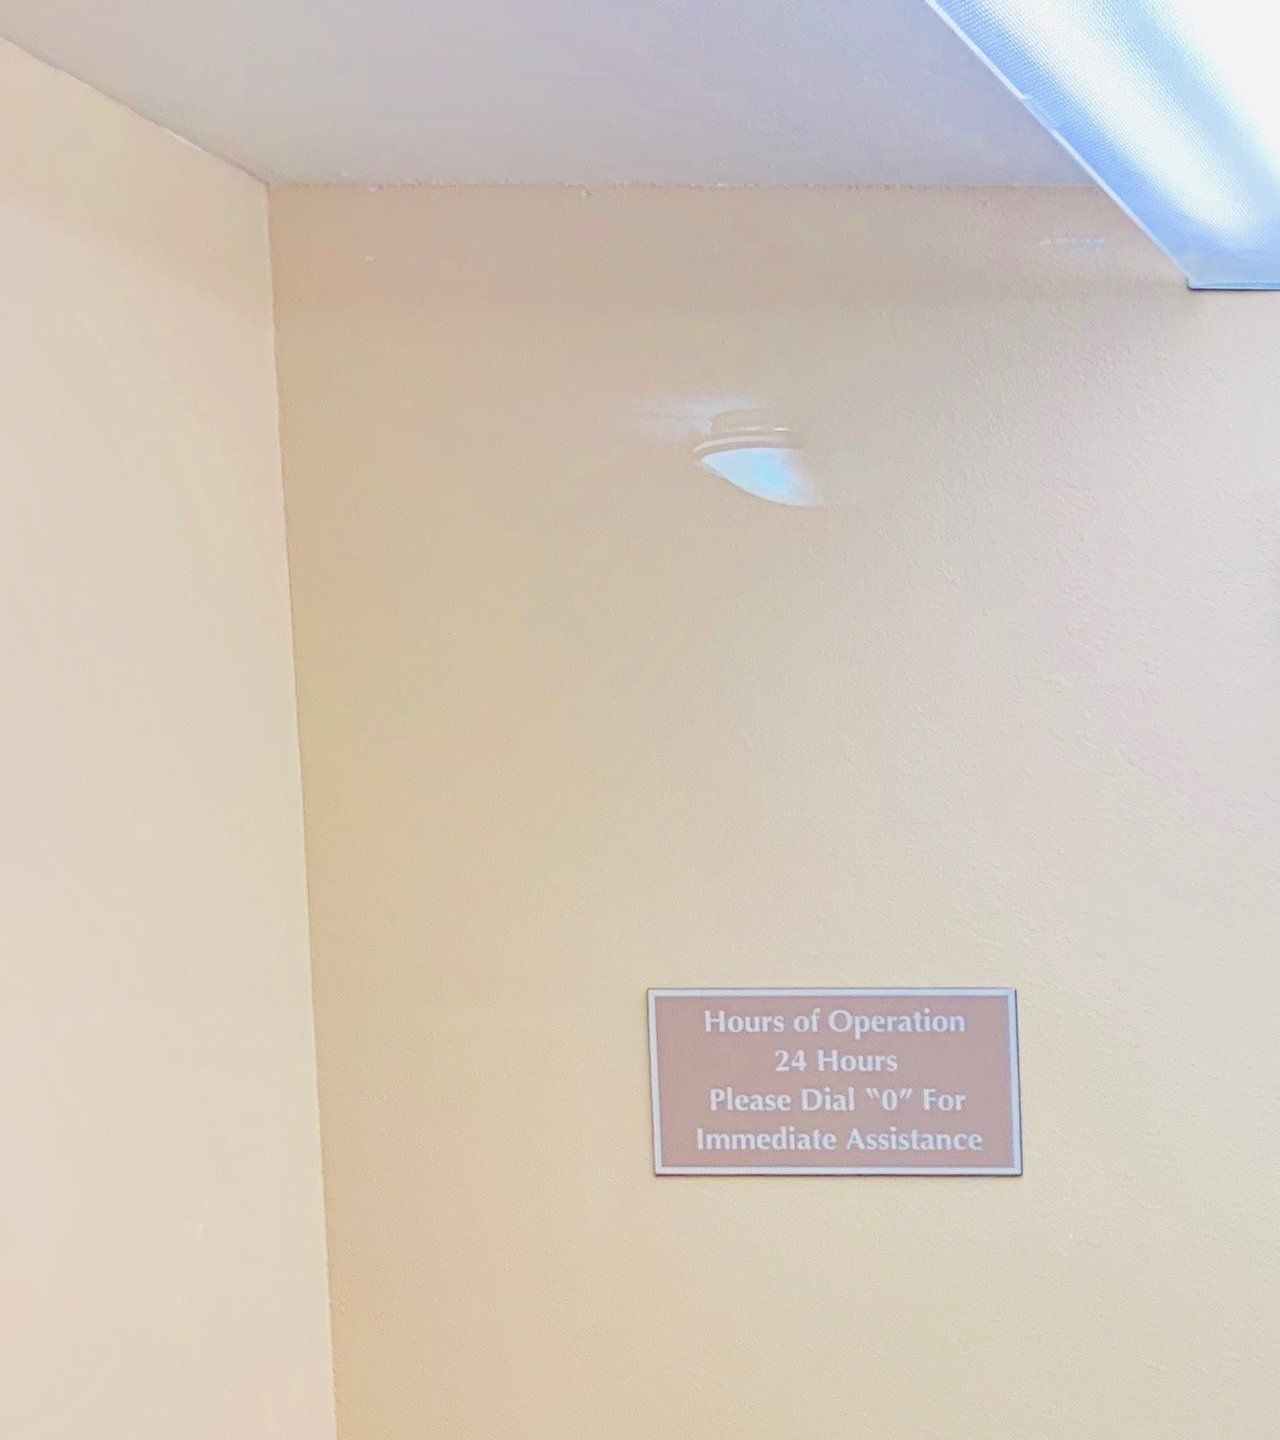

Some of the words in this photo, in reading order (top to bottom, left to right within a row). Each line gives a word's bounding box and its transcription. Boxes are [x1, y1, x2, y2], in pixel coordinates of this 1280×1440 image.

[704, 1009, 785, 1033] Hours
[793, 1008, 821, 1033] of
[828, 1008, 966, 1039] Operation
[774, 1049, 807, 1072] 24
[817, 1049, 898, 1072] Hours
[709, 1087, 792, 1112] Please
[800, 1087, 856, 1112] Dial
[922, 1088, 966, 1112] For
[697, 1126, 837, 1151] Immediate
[845, 1126, 983, 1151] Assistance
